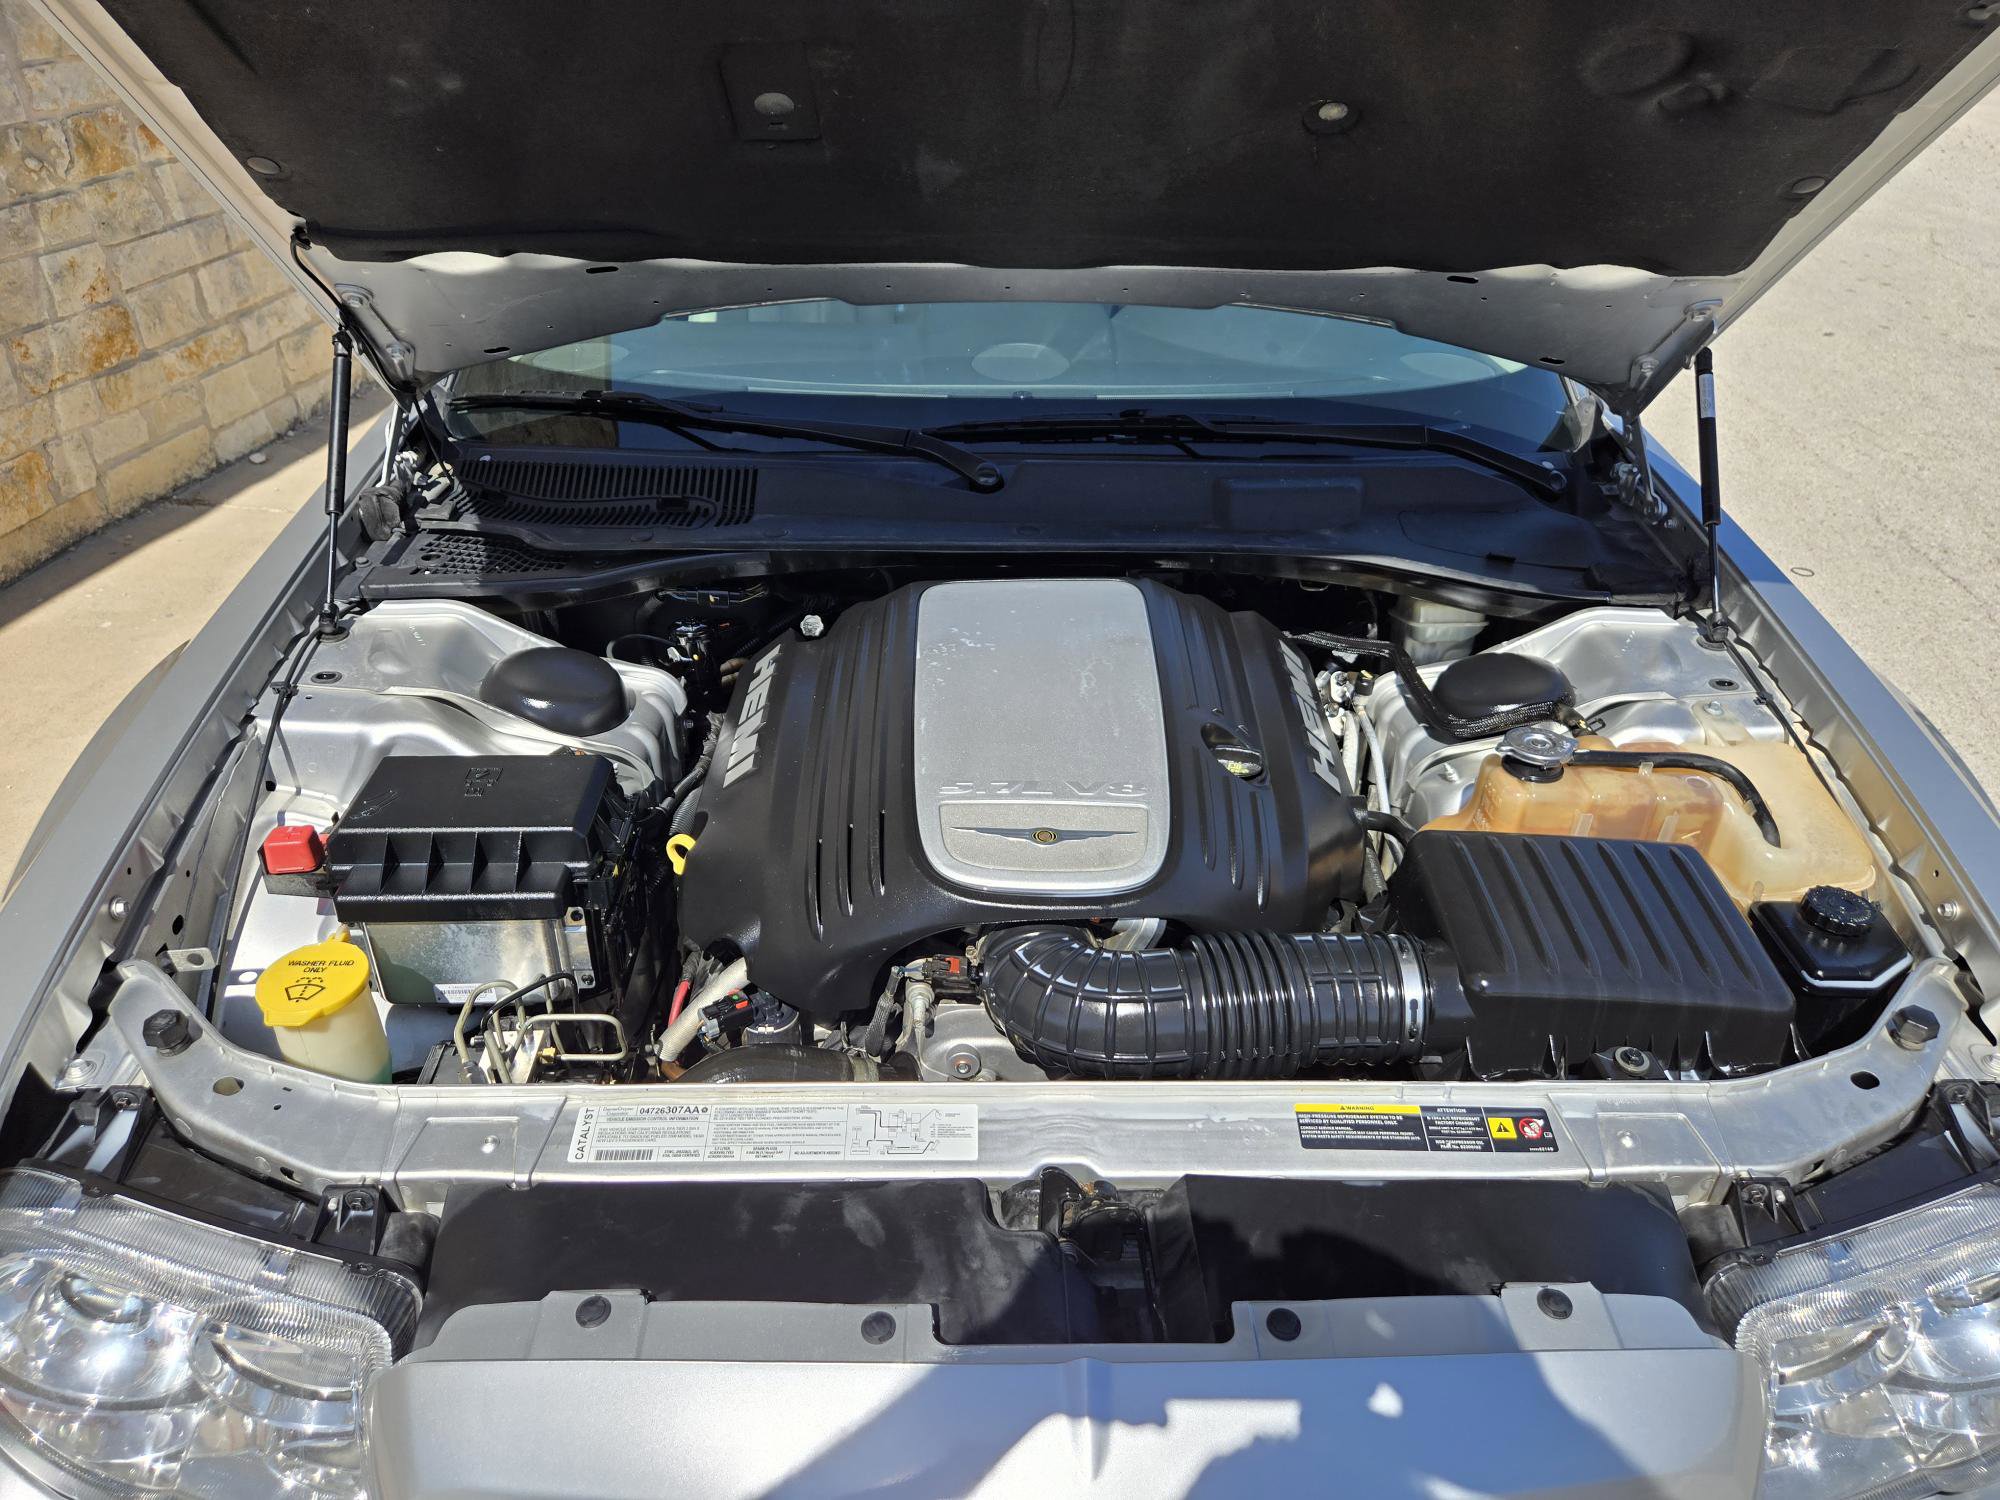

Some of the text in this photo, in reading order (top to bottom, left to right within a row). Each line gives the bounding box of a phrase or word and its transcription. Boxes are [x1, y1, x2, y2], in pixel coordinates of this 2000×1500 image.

[722, 643, 782, 789] HEMI
[575, 1108, 594, 1160] CATALYST
[640, 1106, 700, 1114] 04726307AA
